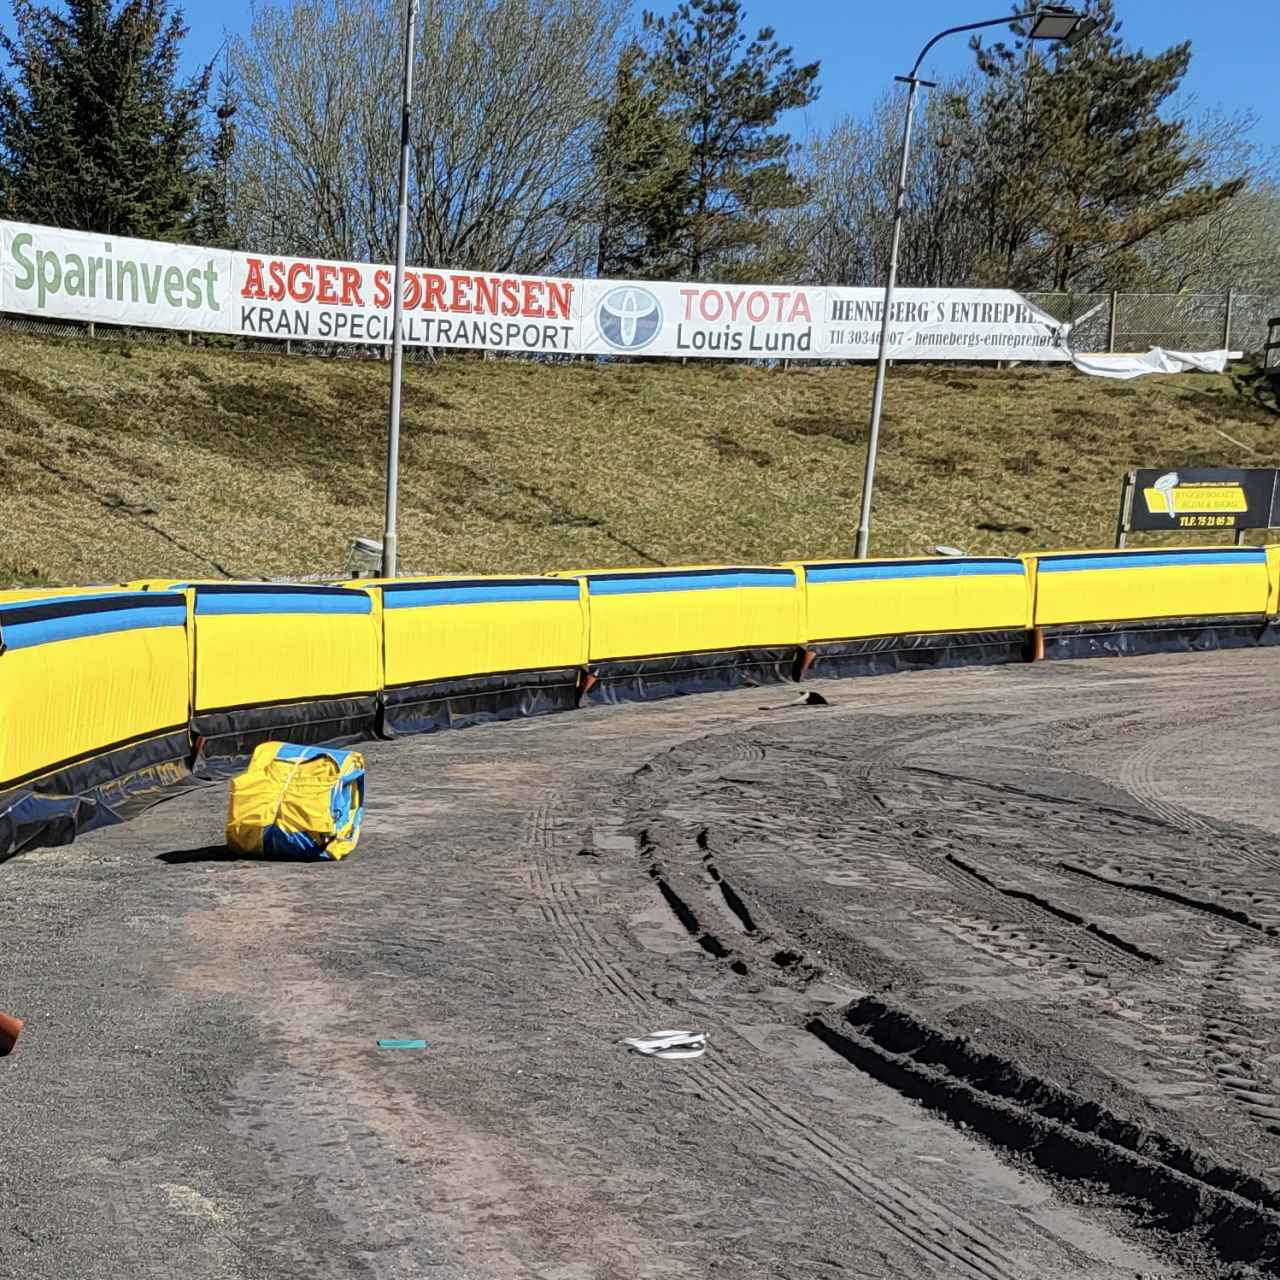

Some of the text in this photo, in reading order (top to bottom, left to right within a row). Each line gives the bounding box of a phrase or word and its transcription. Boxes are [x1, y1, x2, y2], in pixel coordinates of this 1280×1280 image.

[11, 232, 221, 312] Sparinvest
[240, 258, 575, 320] ASGER SØRENSEN
[240, 305, 574, 350] KRAN SPECIALTRANSPORT
[679, 289, 813, 322] TOYOTA
[676, 323, 813, 351] Louis Lund
